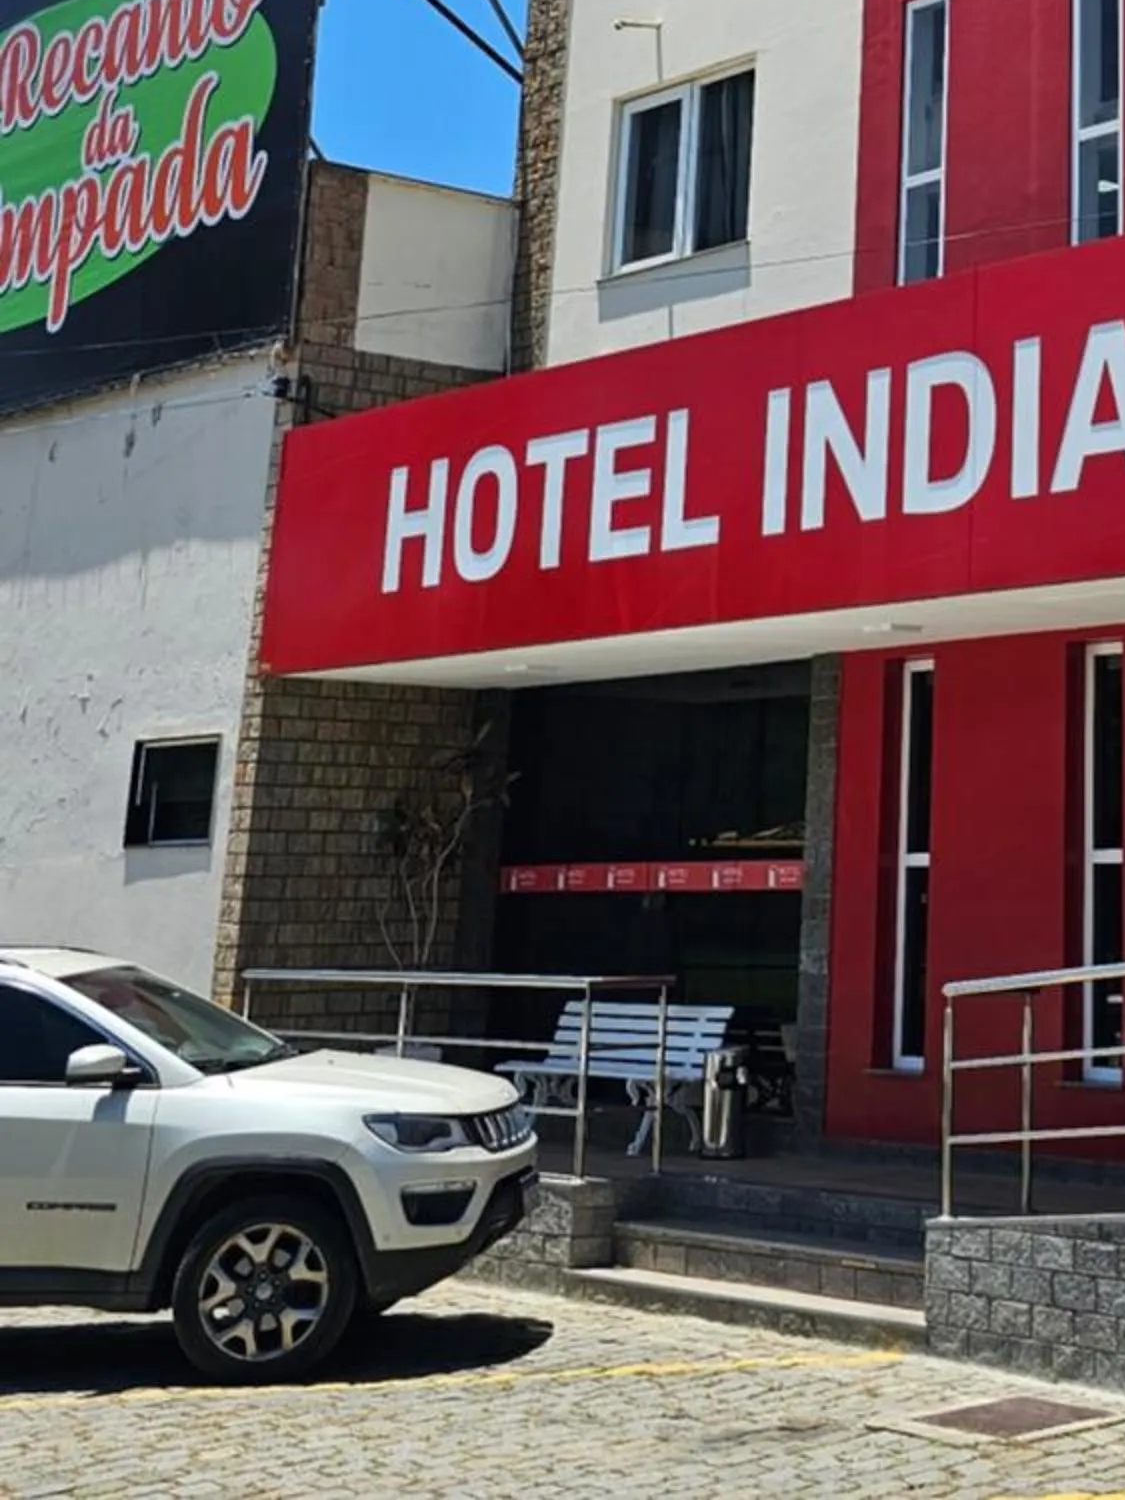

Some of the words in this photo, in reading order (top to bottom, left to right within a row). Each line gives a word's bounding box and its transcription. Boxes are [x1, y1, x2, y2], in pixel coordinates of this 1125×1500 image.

[0, 71, 268, 334] mpada
[81, 88, 140, 171] da
[380, 407, 721, 594] HOTEL
